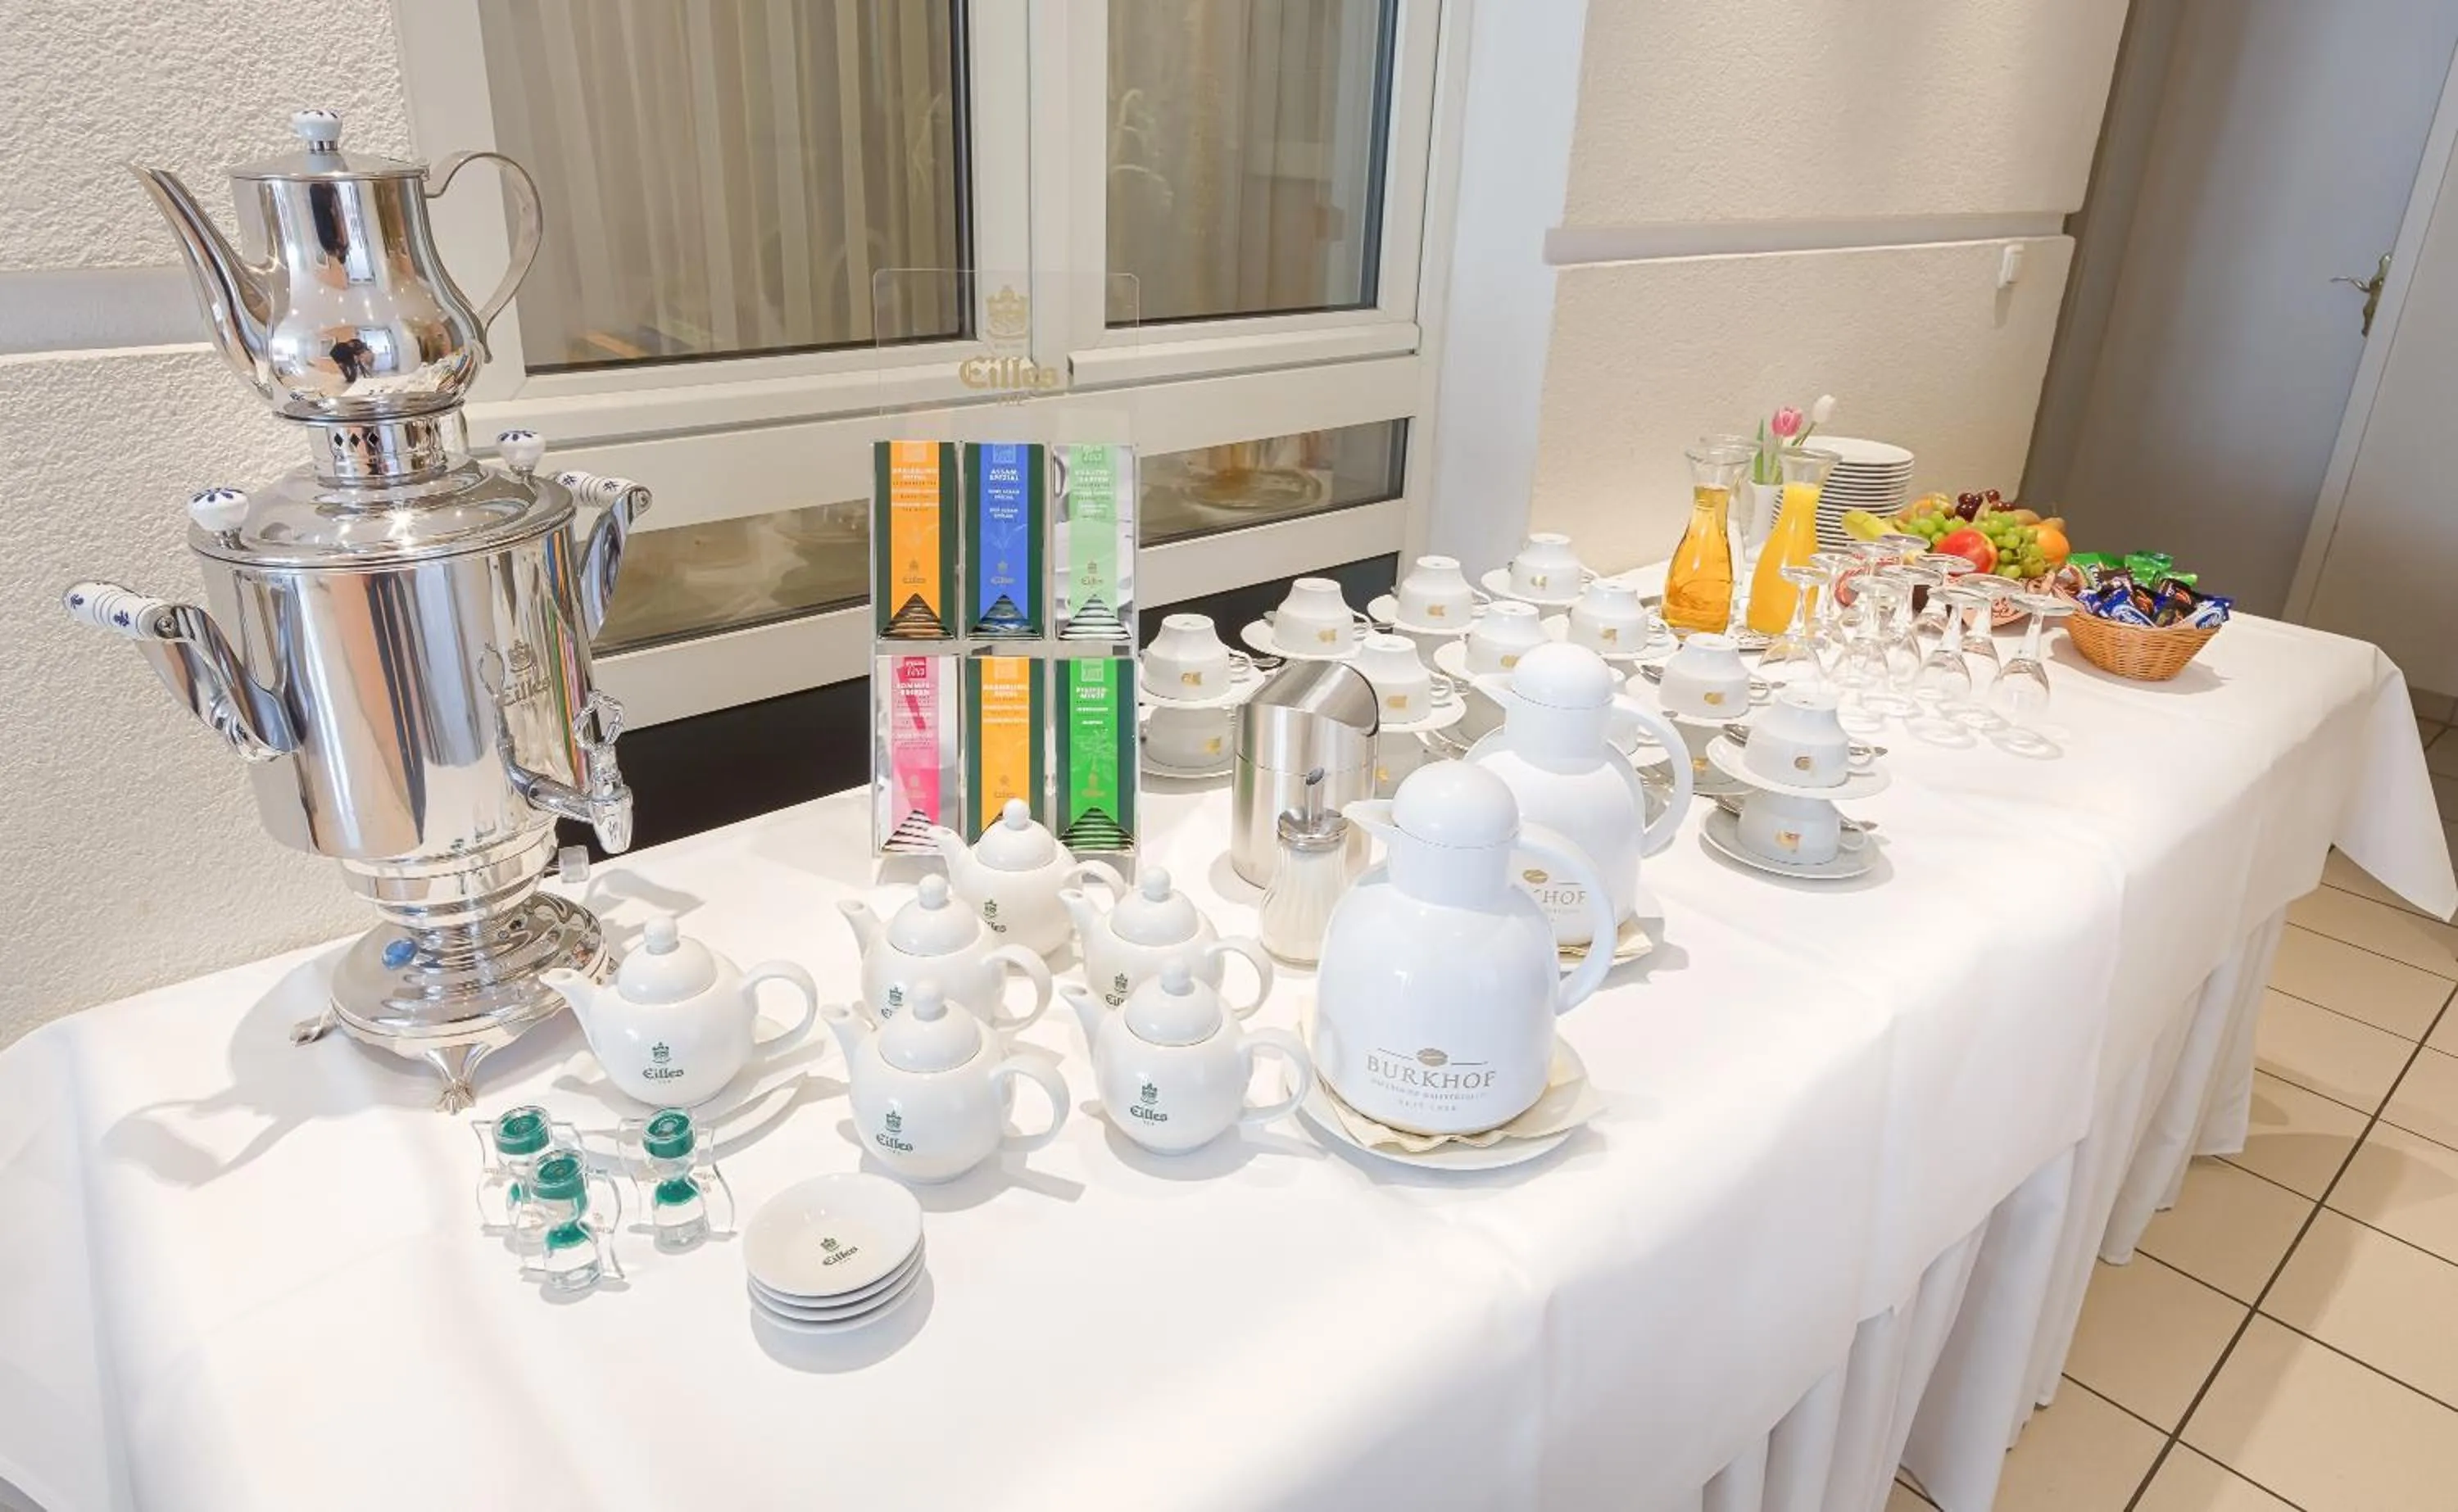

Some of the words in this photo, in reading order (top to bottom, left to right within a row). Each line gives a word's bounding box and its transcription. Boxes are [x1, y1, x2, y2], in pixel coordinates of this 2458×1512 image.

[958, 355, 1060, 389] Eilles
[495, 677, 551, 707] Eilles
[642, 1067, 684, 1079] Eilles
[1367, 1054, 1497, 1089] BURKHOF
[1130, 1105, 1168, 1122] Eilles
[876, 1133, 914, 1152] Eilles
[823, 1246, 859, 1265] Eilles
